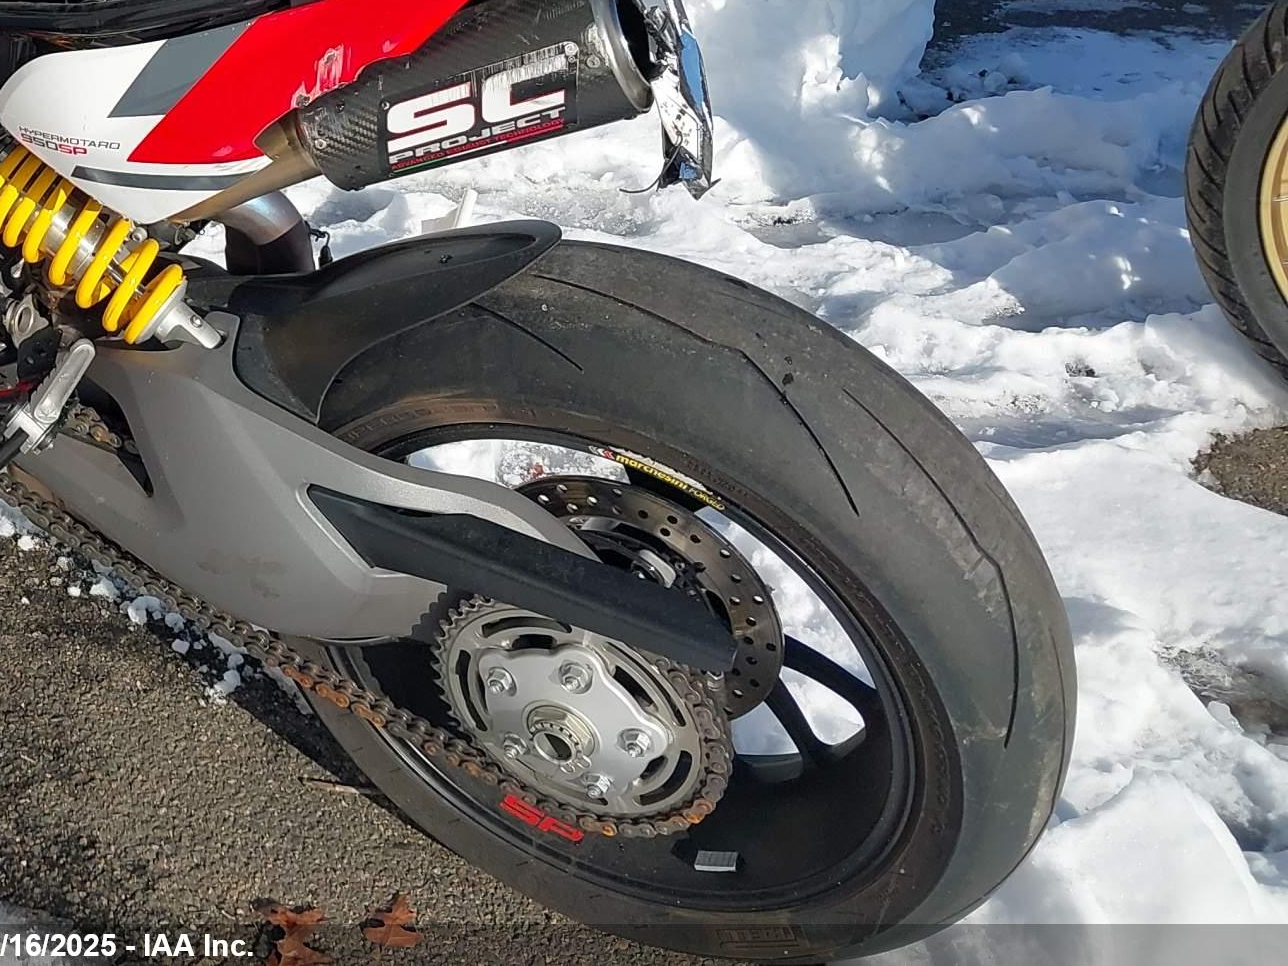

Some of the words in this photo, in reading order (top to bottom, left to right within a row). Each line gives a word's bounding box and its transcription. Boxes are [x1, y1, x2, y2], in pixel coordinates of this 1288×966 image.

[387, 53, 565, 153] SC
[19, 126, 121, 150] HYPERMOTARD
[20, 133, 88, 155] 950SP
[389, 106, 566, 164] PROJECT
[391, 152, 445, 171] ADVANCED
[446, 139, 492, 156] EXHAUST
[493, 118, 565, 141] TECHNOLOGY
[689, 487, 726, 511] FORGED
[499, 794, 585, 842] SP
